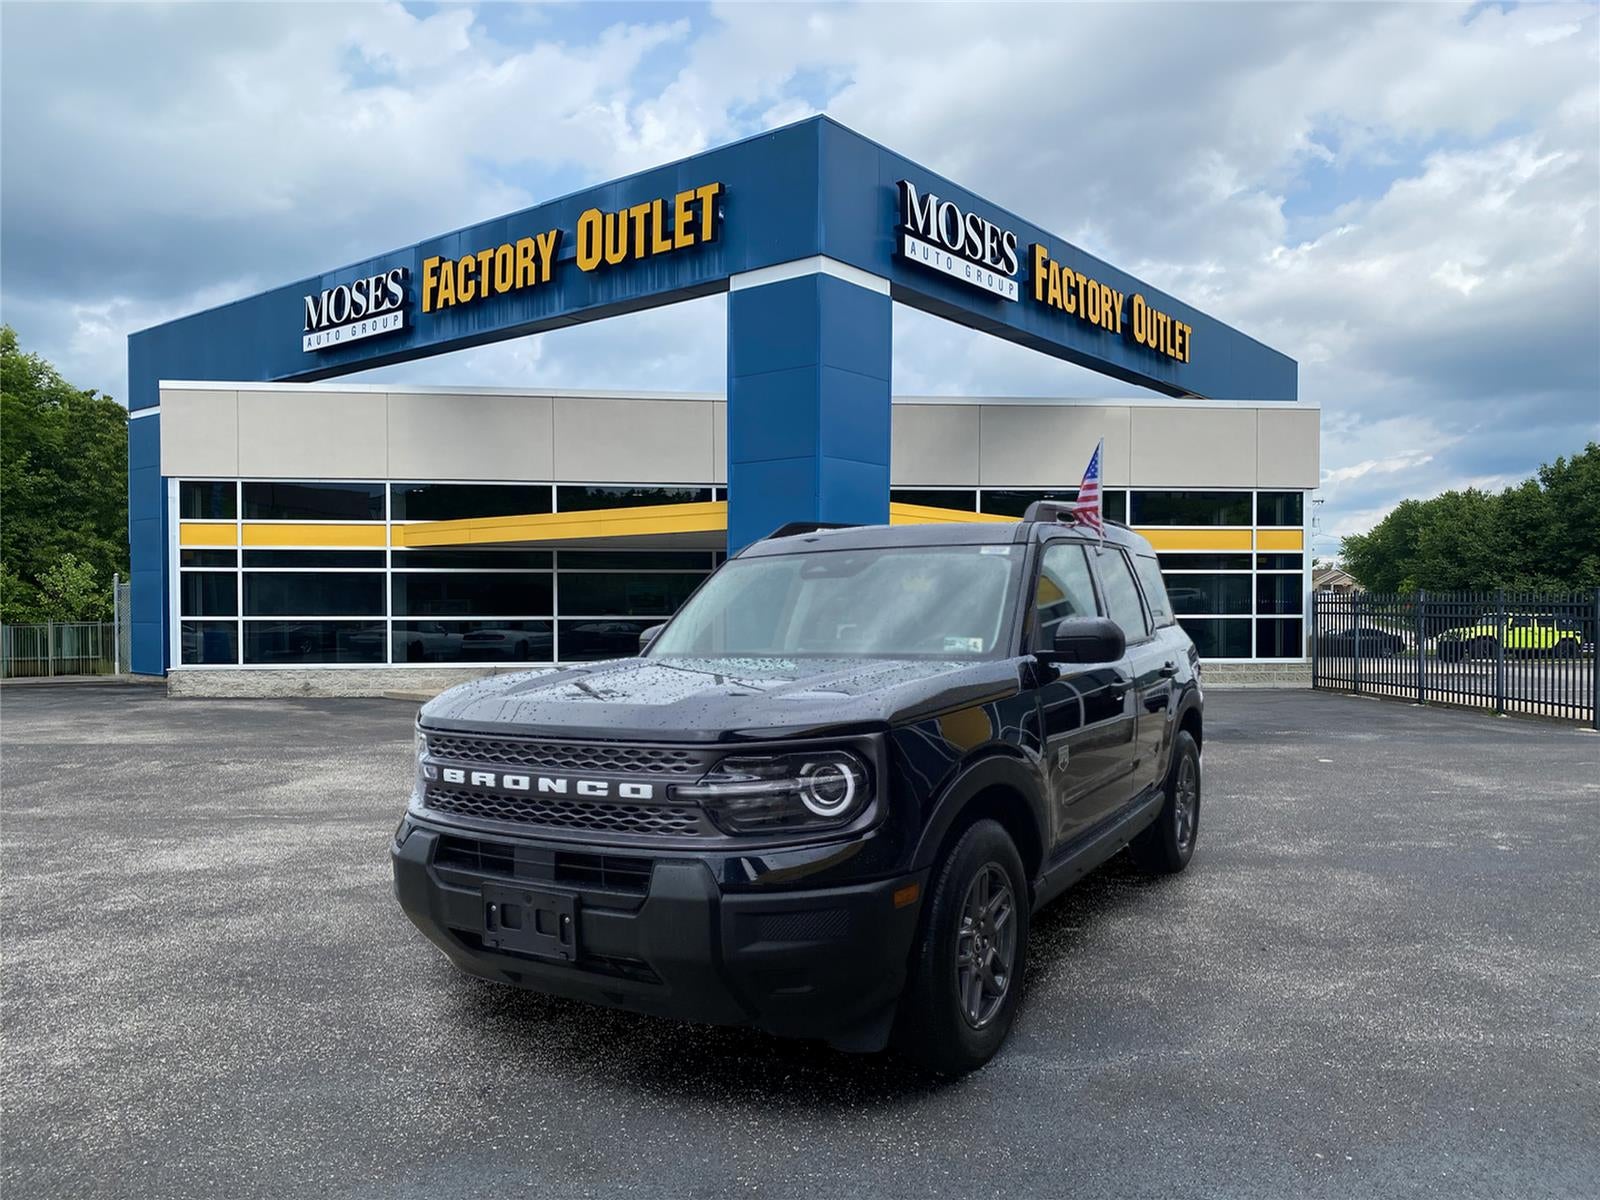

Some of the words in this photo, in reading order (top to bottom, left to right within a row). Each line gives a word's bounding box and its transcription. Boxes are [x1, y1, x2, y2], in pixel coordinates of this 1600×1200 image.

[422, 228, 560, 313] FACTORY
[576, 182, 720, 272] OUTLET
[903, 180, 1019, 277] MOSES
[303, 268, 404, 331] MOSES
[909, 240, 953, 271] AUTO
[965, 264, 1015, 296] GROUP
[306, 329, 341, 348] AUTO
[350, 314, 400, 337] GROUP
[1034, 243, 1124, 335] FACTORY
[1131, 293, 1193, 364] OUTLET
[442, 768, 654, 800] BRONCO
